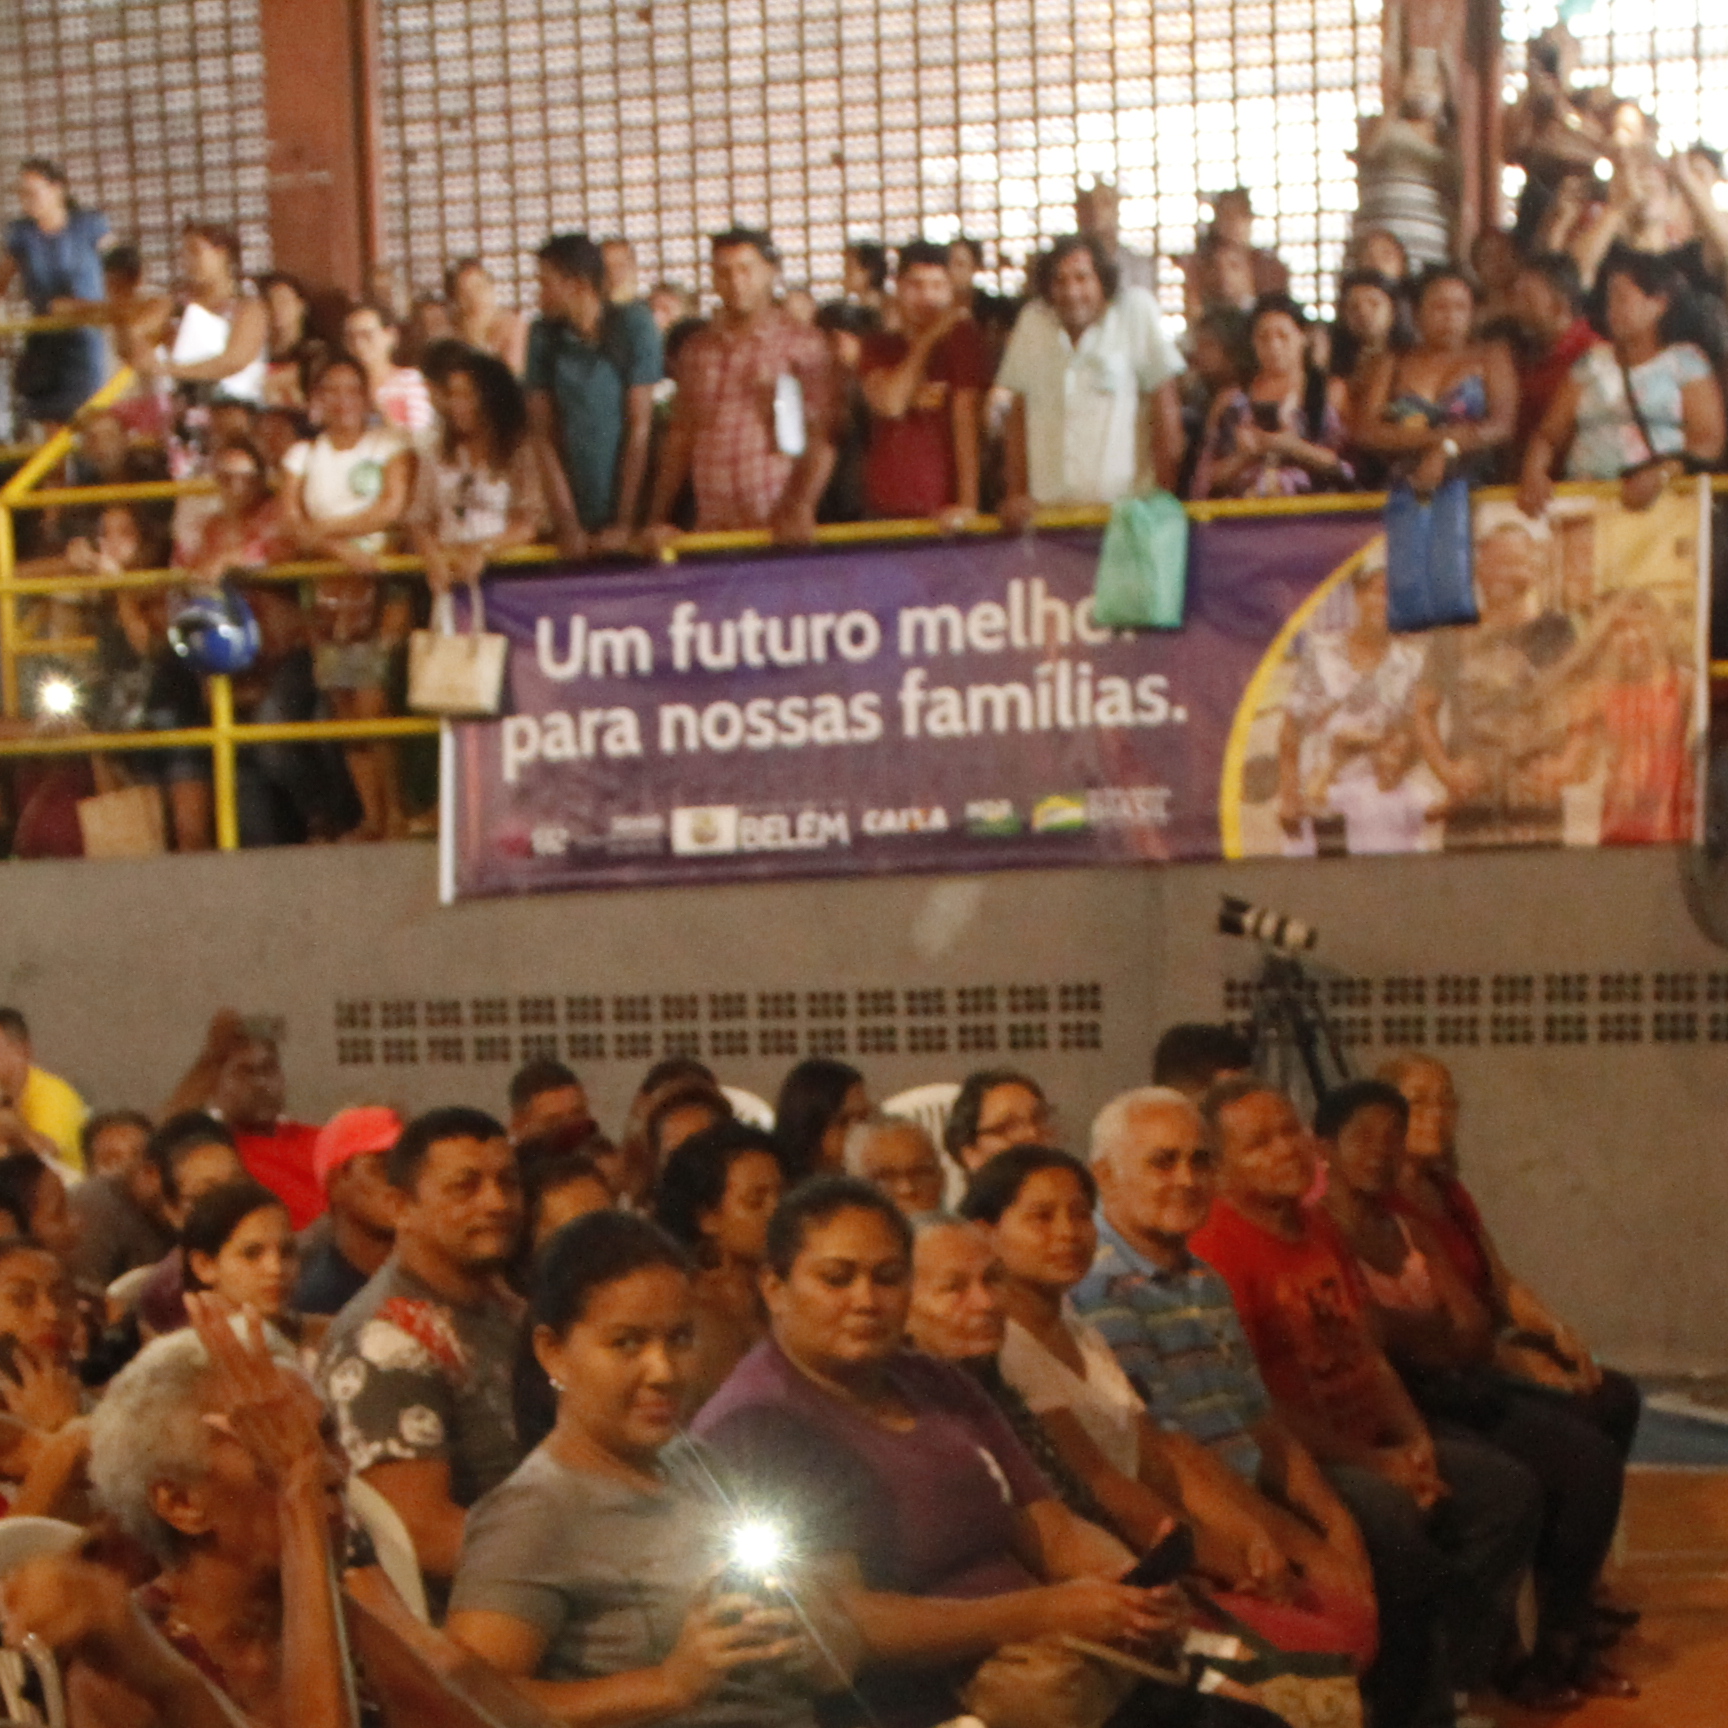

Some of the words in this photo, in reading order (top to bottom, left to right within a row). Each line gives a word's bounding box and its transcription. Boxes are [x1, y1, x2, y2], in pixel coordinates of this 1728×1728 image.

[536, 614, 653, 681] Um
[668, 602, 881, 672] futuro
[898, 577, 1138, 656] melho
[501, 704, 642, 782] para
[658, 691, 884, 753] nossas
[897, 661, 1189, 738] famílias.
